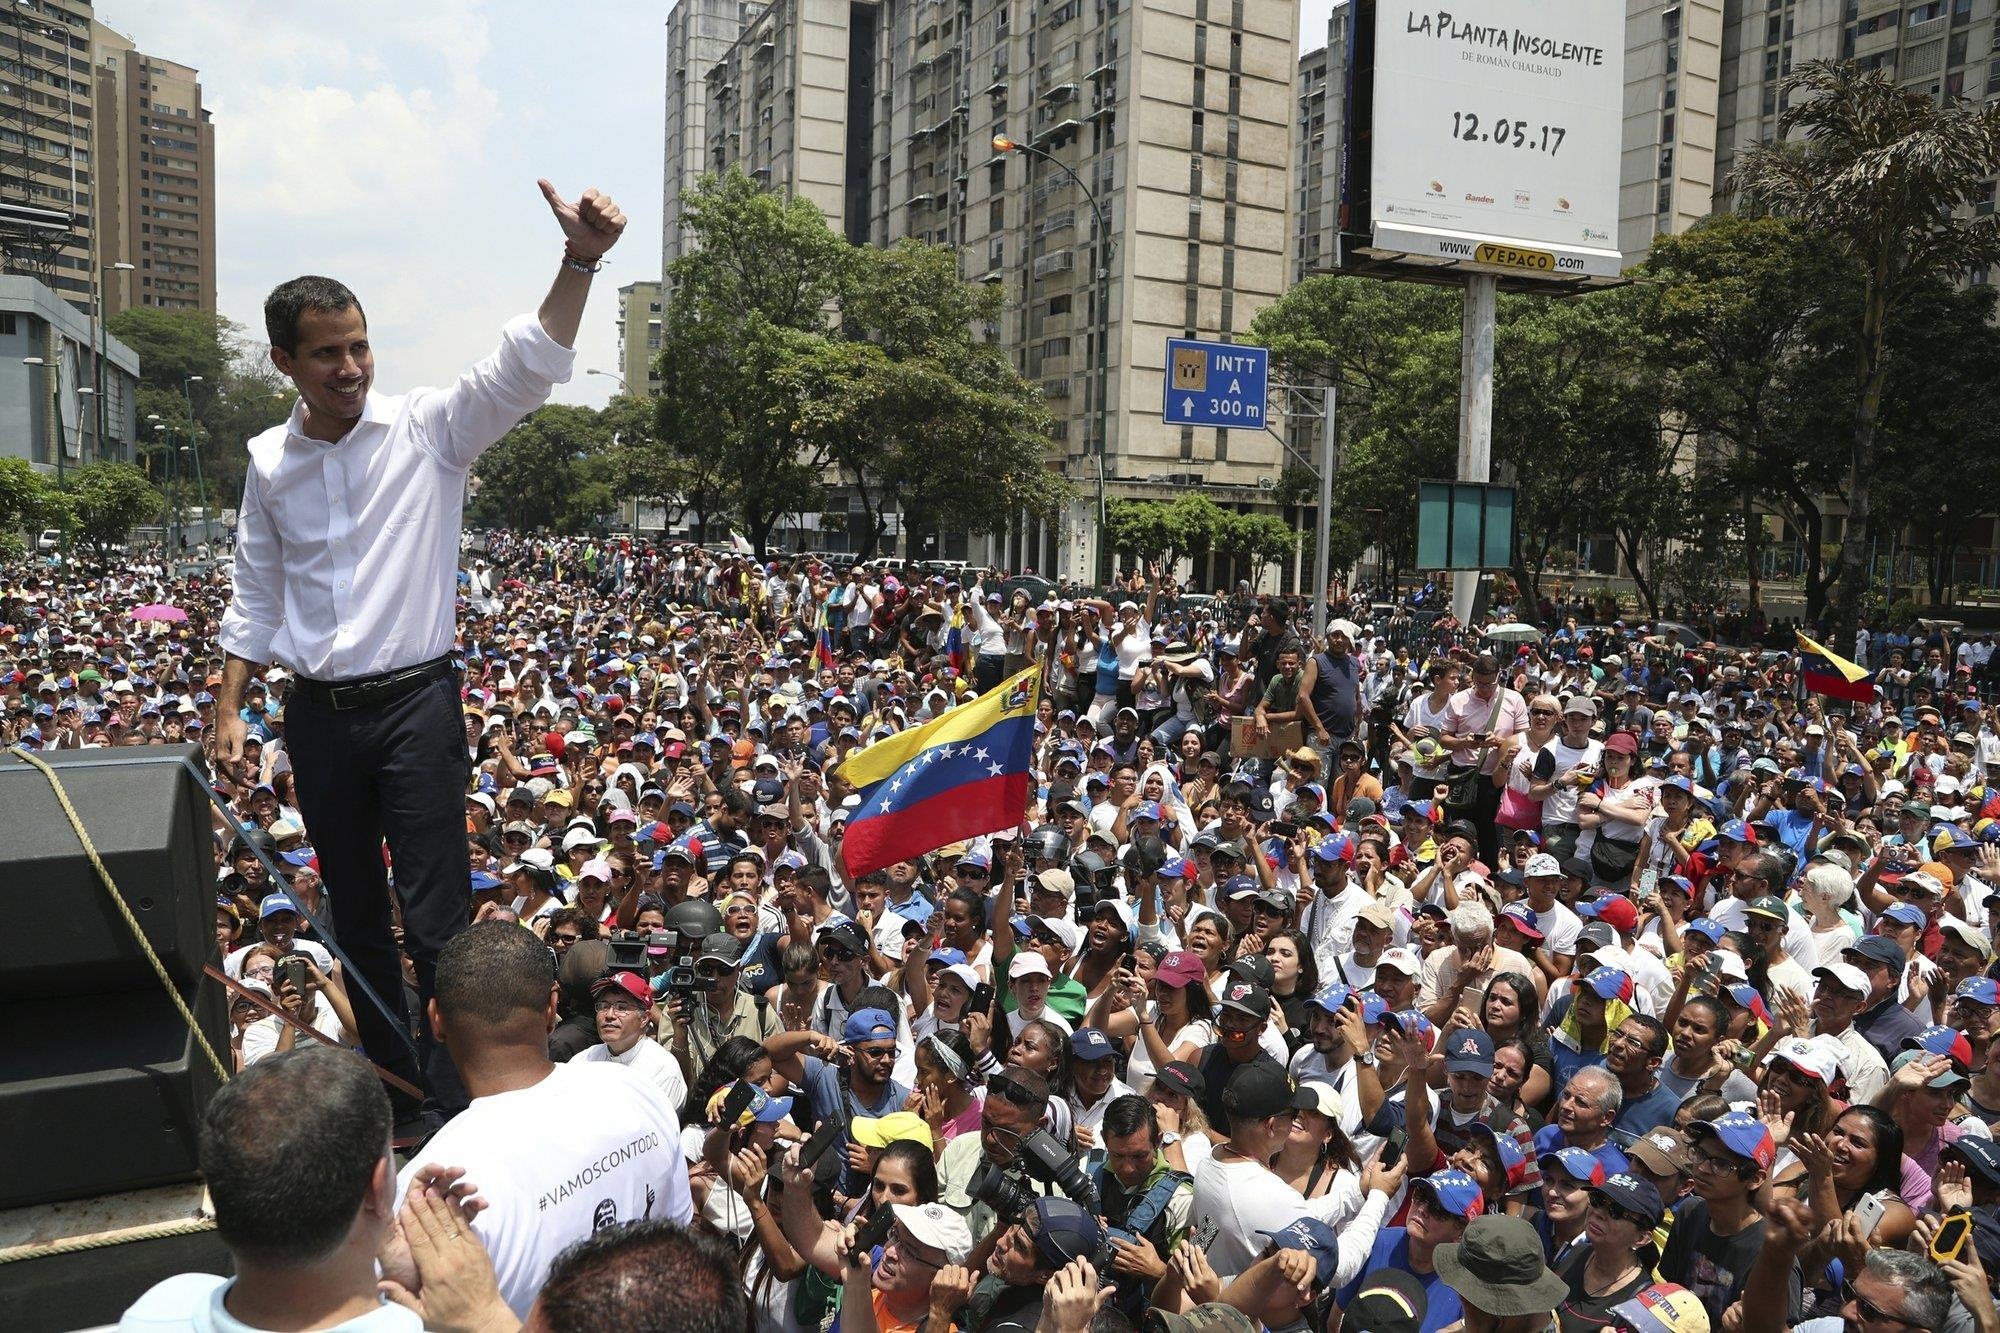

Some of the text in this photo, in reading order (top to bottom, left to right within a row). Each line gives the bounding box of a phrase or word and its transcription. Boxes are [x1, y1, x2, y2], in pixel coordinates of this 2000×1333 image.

[1407, 11, 1603, 66] LA PLANTA INSOLENTE
[1461, 51, 1562, 78] DE ROMÁN CHALBAUD
[1453, 111, 1566, 156] 12.05.17
[1465, 193, 1495, 204] Bandes
[1440, 241, 1584, 270] www. VEPACO .com
[1216, 355, 1256, 373] INTT
[1228, 379, 1241, 394] A
[1210, 398, 1259, 418] 300 m
[538, 1131, 659, 1212] #VAMOSCONTODO
